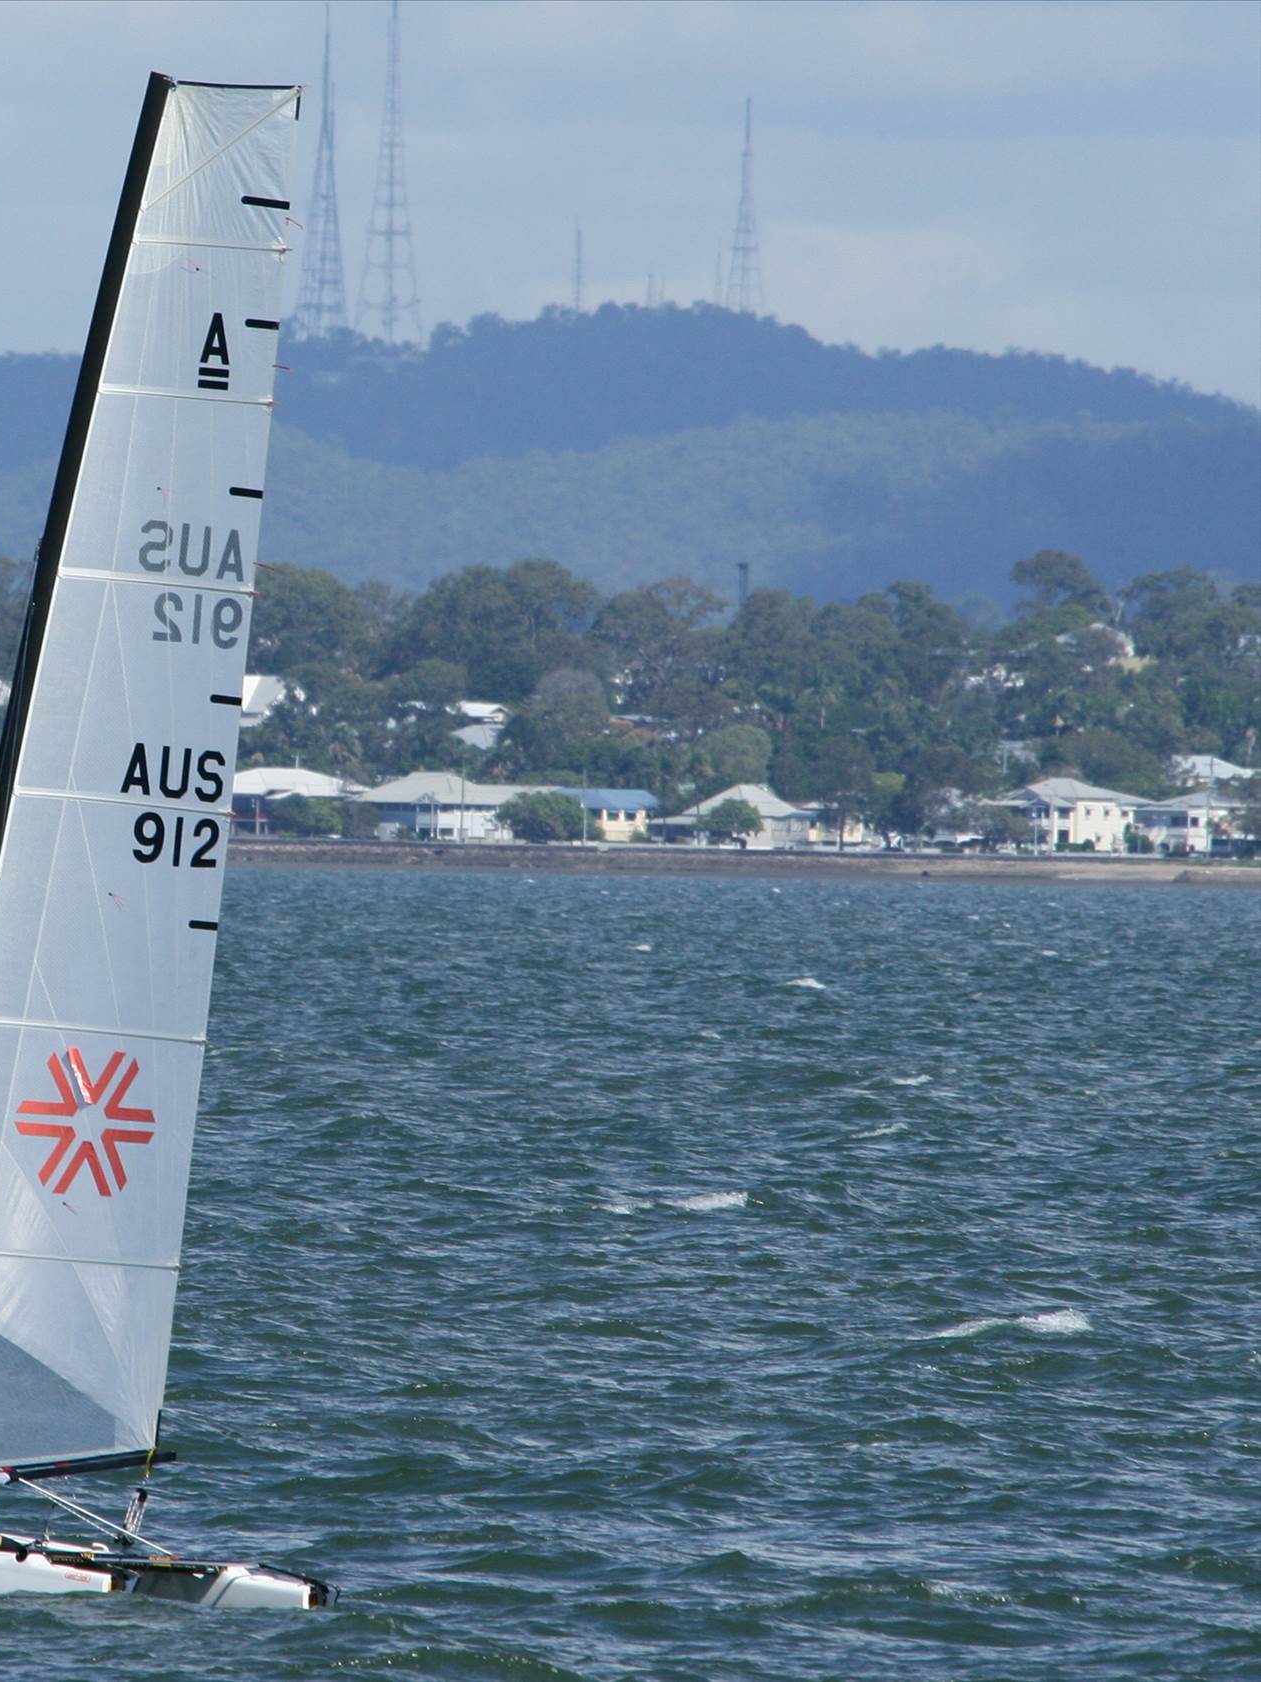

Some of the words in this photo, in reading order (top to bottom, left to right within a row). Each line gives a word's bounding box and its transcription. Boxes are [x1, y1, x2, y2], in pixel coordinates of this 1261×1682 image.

[199, 312, 230, 366] A
[120, 742, 226, 803] AUS
[132, 811, 220, 868] 912
